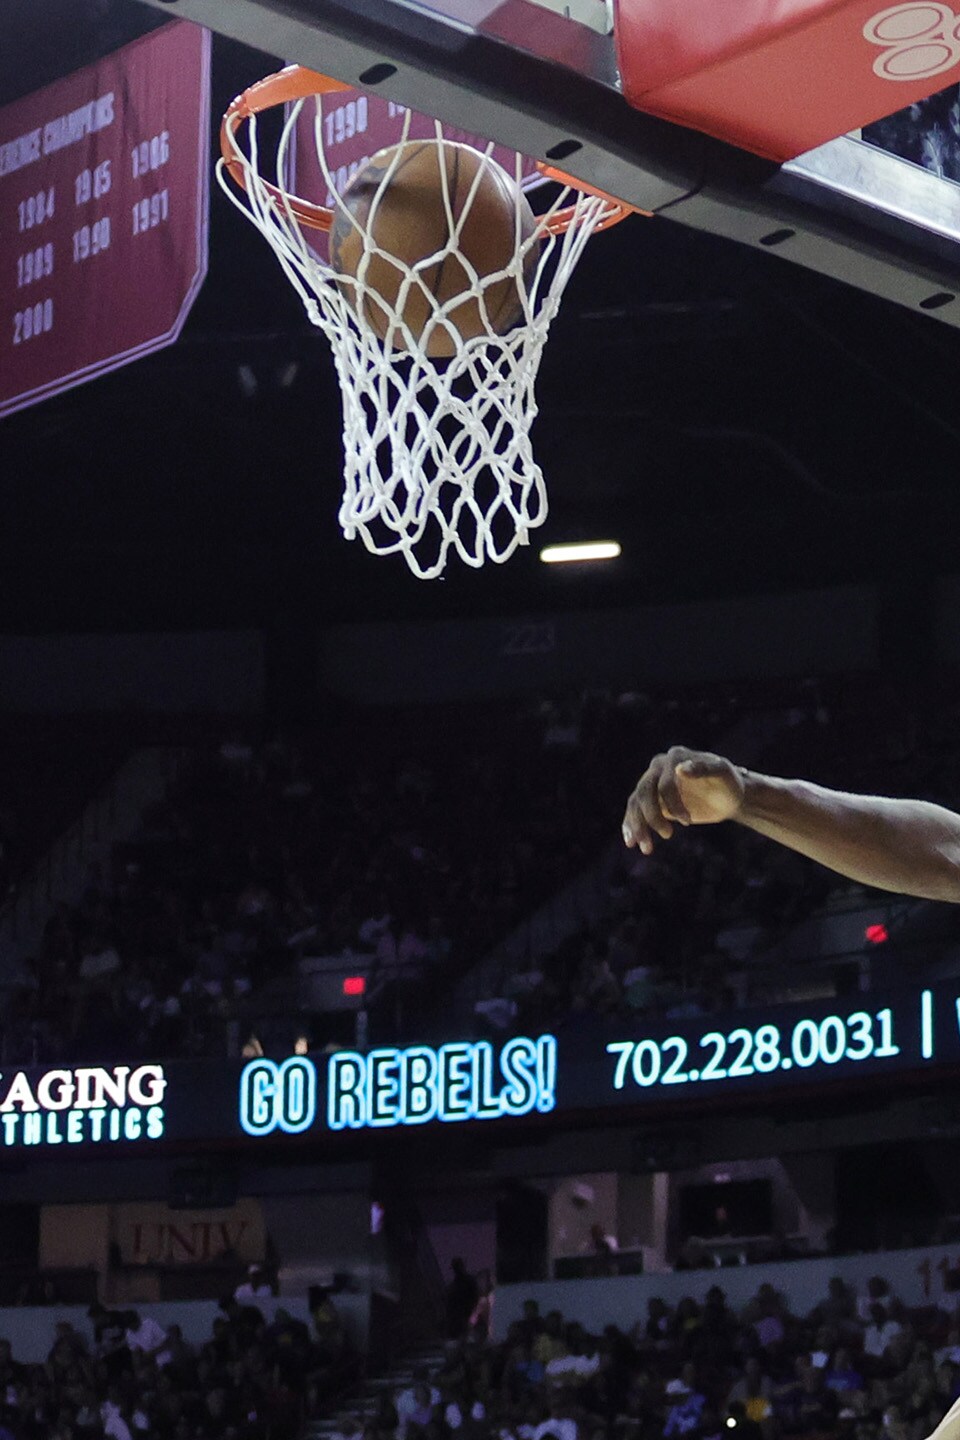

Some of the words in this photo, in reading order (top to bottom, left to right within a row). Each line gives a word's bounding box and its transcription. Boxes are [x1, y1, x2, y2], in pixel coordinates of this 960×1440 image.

[13, 298, 54, 344] 2000
[606, 1007, 900, 1090] 702.228.0031
[0, 1065, 167, 1112] AGING
[240, 1057, 316, 1136] GO
[327, 1034, 556, 1130] REBELS!
[1, 1106, 164, 1146] THLETICS
